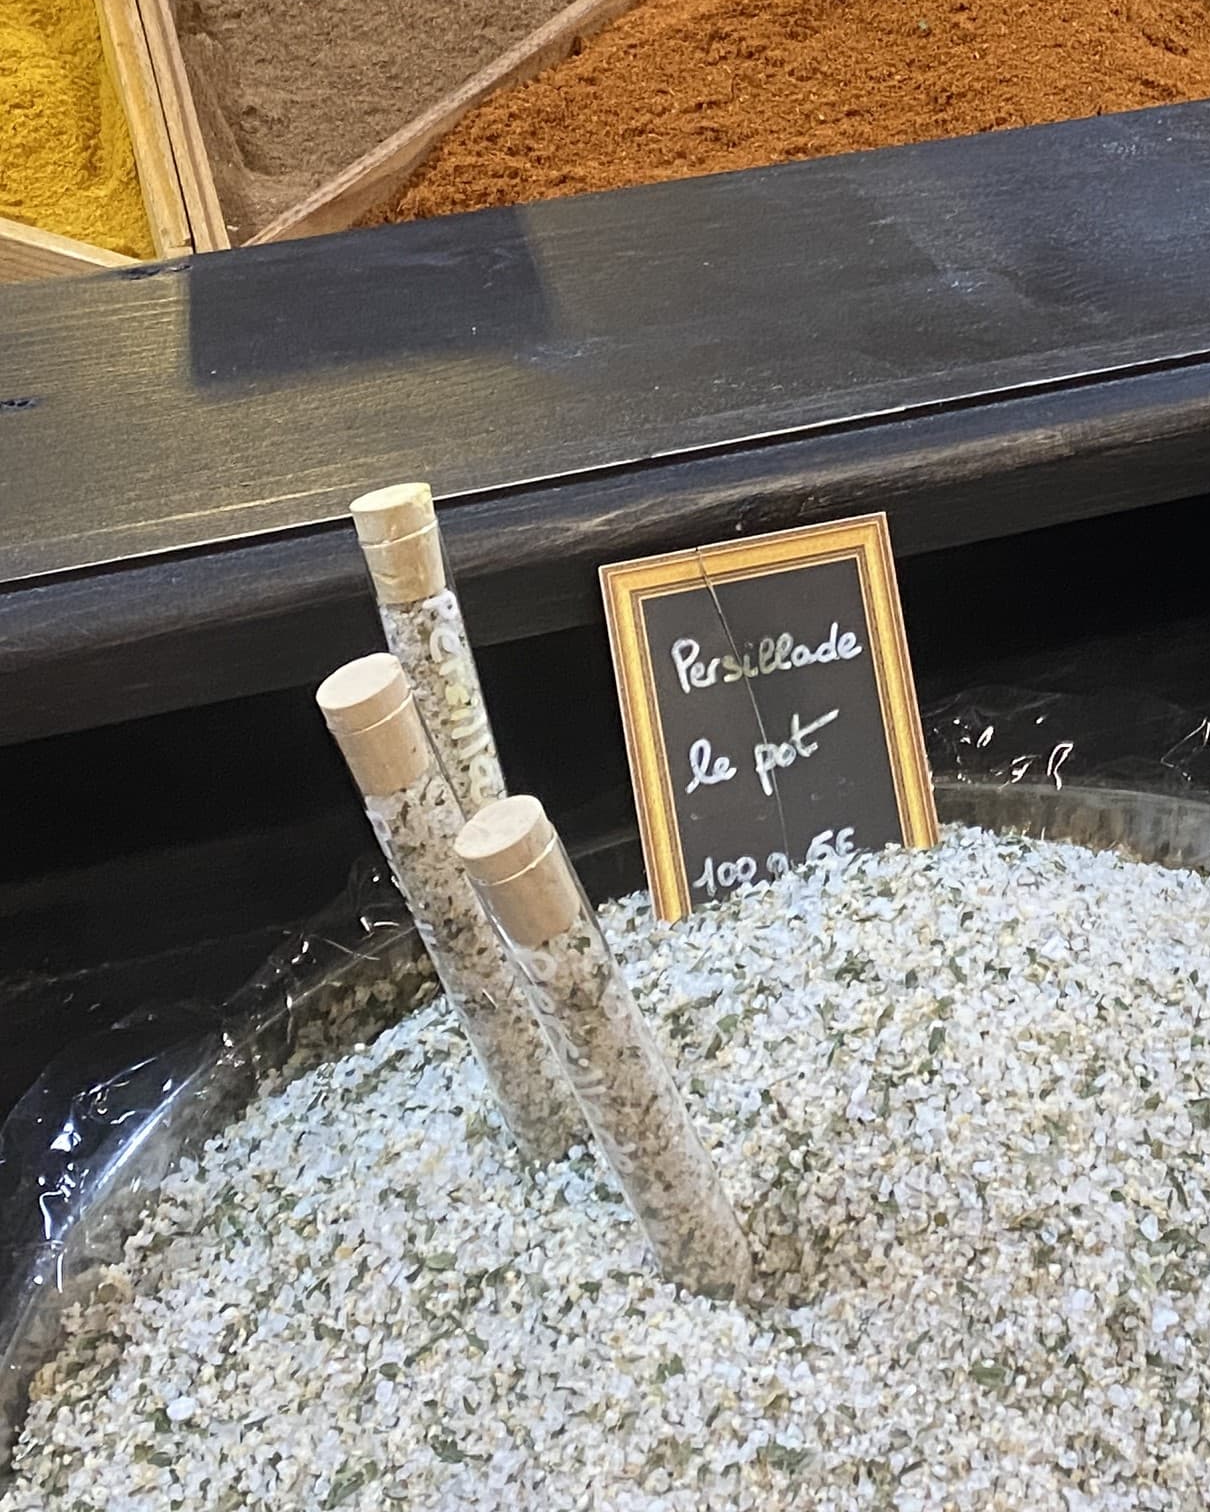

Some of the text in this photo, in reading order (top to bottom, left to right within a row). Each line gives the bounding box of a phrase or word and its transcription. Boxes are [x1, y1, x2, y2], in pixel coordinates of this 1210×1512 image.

[670, 622, 863, 694] Persillade
[685, 709, 840, 797] le pot
